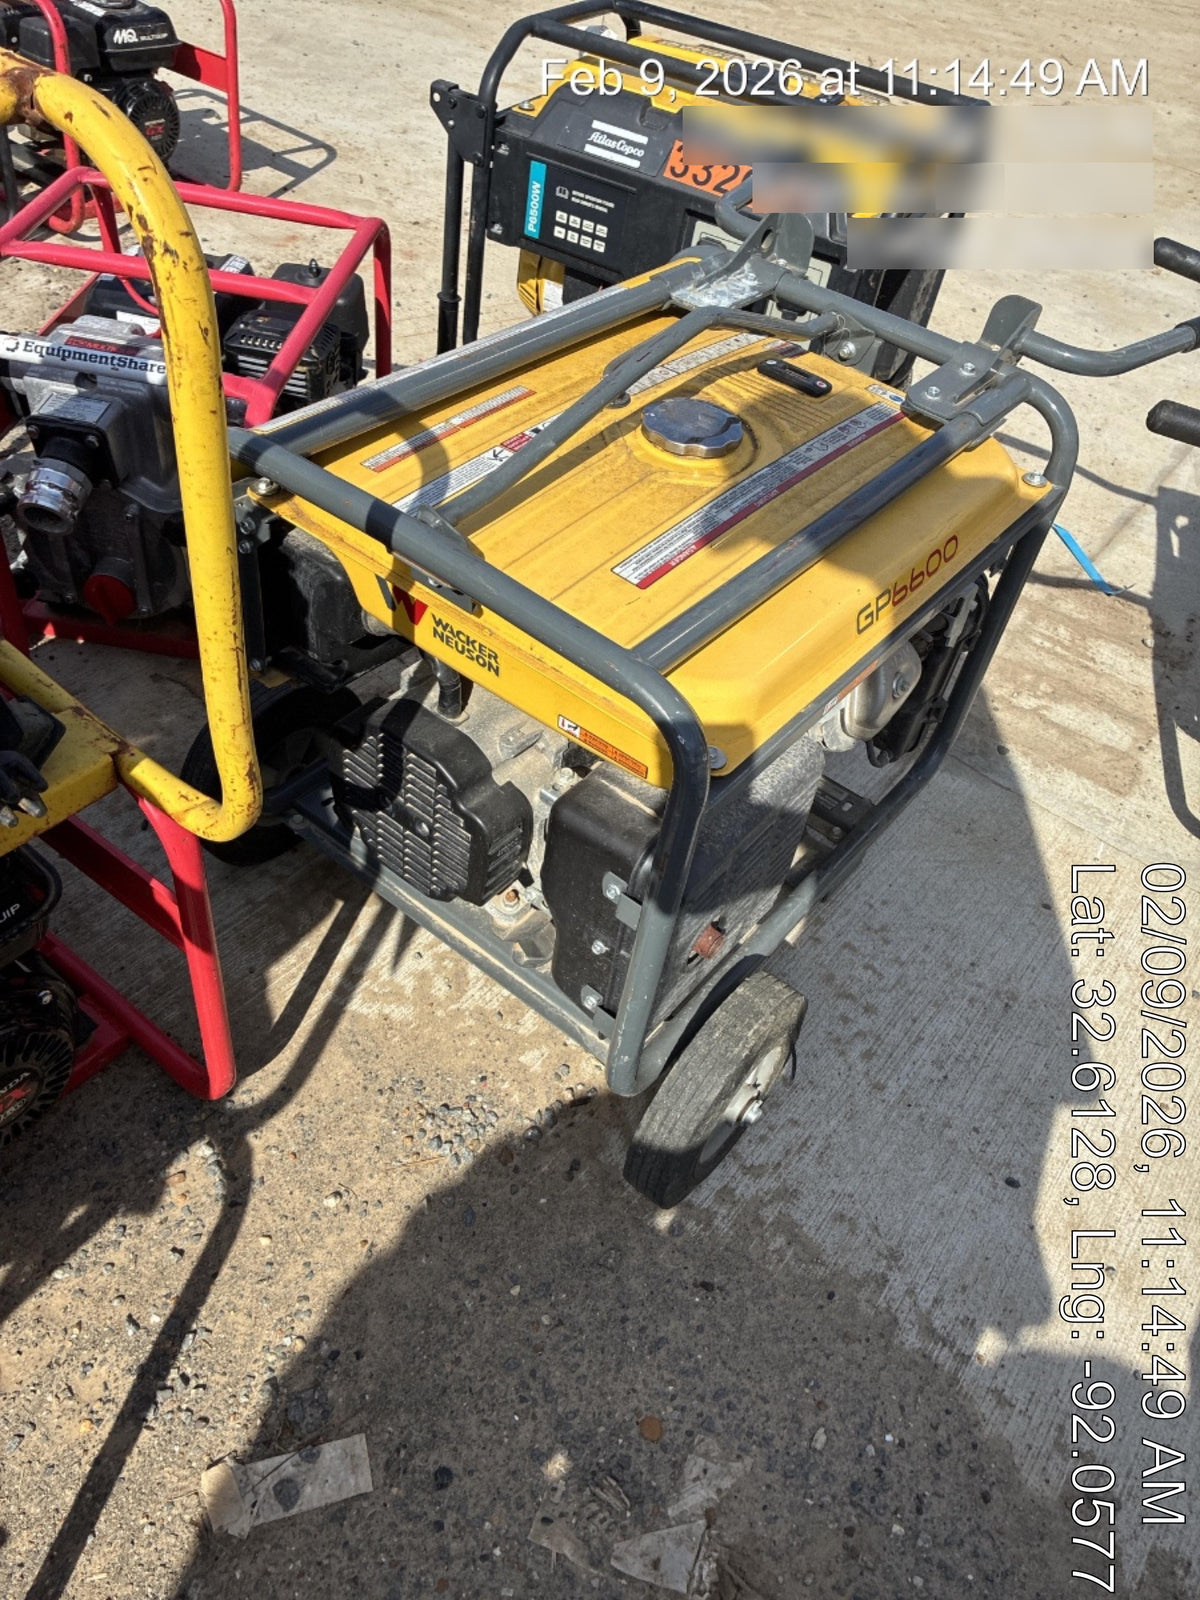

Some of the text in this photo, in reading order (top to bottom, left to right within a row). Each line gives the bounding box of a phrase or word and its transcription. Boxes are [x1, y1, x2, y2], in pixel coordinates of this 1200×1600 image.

[112, 28, 139, 44] MQ
[527, 180, 542, 233] P6500W
[23, 340, 167, 375] EquipmentShare
[856, 534, 959, 635] GP6600
[431, 612, 500, 665] WACKER
[432, 626, 500, 677] NEUSON
